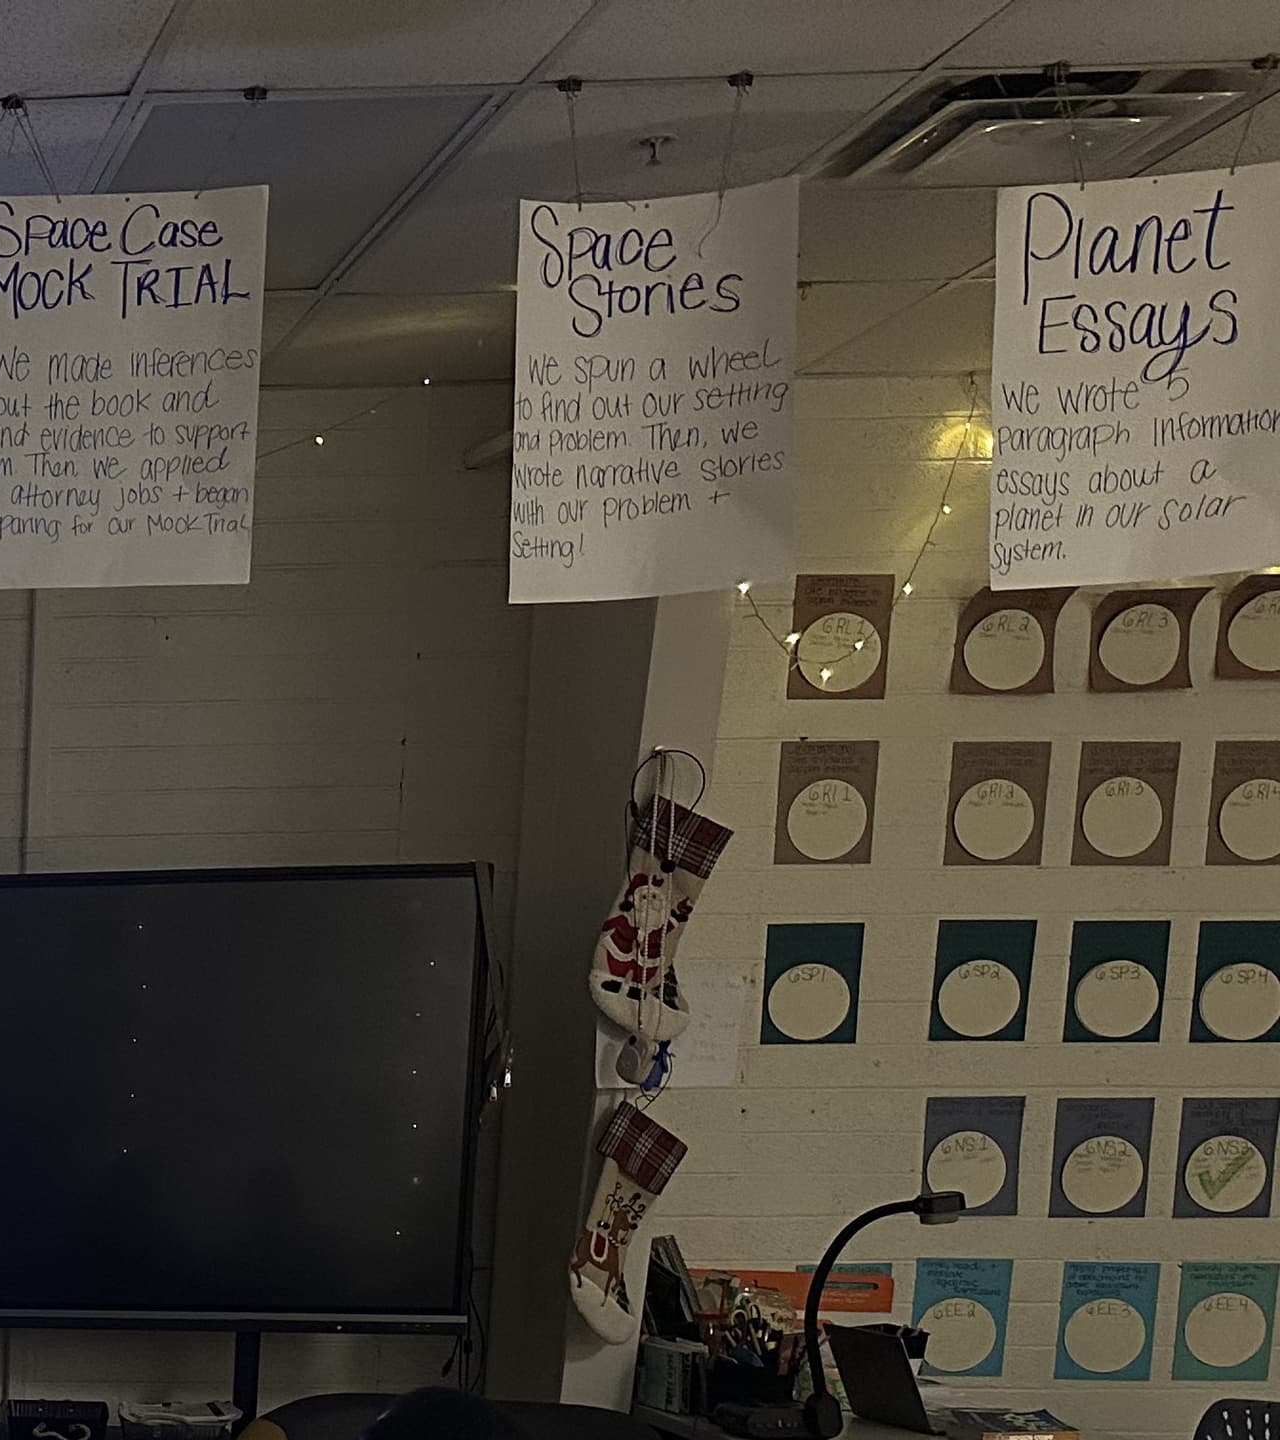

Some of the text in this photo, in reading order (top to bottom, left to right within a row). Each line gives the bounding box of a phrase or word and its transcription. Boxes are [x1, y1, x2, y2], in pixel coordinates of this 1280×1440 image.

[120, 204, 224, 256] Case
[531, 205, 676, 287] Space
[1023, 189, 1234, 305] Planet
[569, 273, 743, 338] Stories
[1039, 289, 1238, 384] Essays
[48, 353, 113, 384] made
[131, 348, 258, 378] inferences
[574, 355, 635, 393] spun
[649, 356, 666, 382] a
[689, 338, 781, 380] wheel
[44, 393, 80, 420] the
[91, 389, 151, 417] book
[162, 379, 220, 413] and
[515, 399, 532, 422] to
[541, 391, 580, 423] find
[593, 399, 633, 419] out
[693, 382, 789, 412] setting
[1057, 376, 1140, 415] wrote
[1167, 368, 1190, 401] 5
[40, 427, 135, 451] evidence
[643, 420, 759, 451] Then, we
[576, 451, 785, 488] narrative stories
[996, 459, 1217, 505] essays about a
[72, 515, 93, 537] for
[107, 517, 135, 535] our
[147, 513, 202, 536] Mock
[995, 502, 1152, 540] planet in our
[991, 540, 1066, 576] system.
